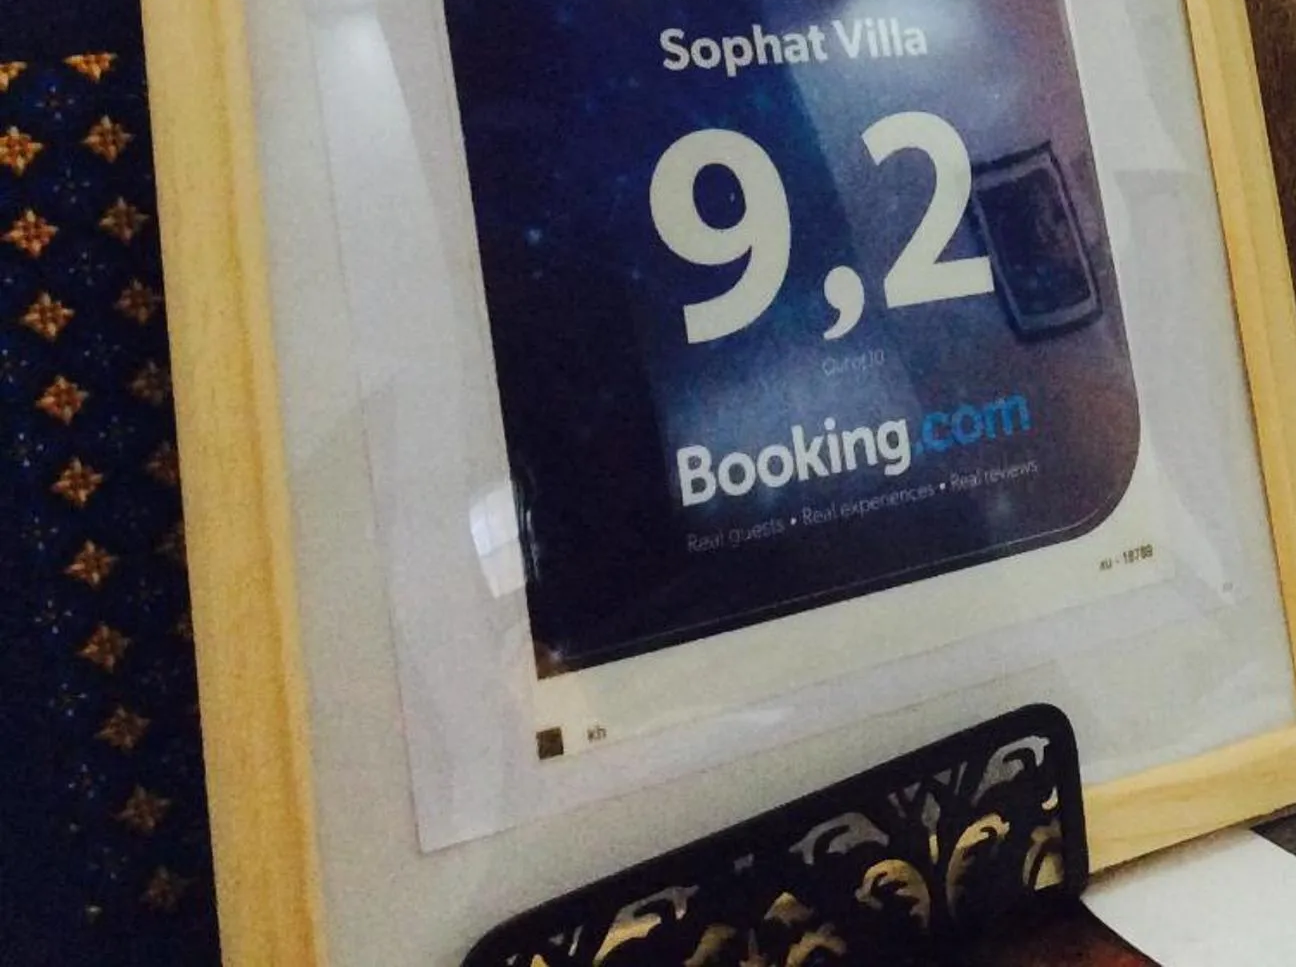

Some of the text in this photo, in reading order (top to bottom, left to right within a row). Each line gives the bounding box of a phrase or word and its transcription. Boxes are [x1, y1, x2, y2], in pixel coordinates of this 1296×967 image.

[659, 17, 928, 78] Sophat Villa
[649, 111, 994, 344] 9,2
[676, 393, 1031, 507] Booking.com
[687, 460, 1039, 553] Real guests Real experiences Real reviews
